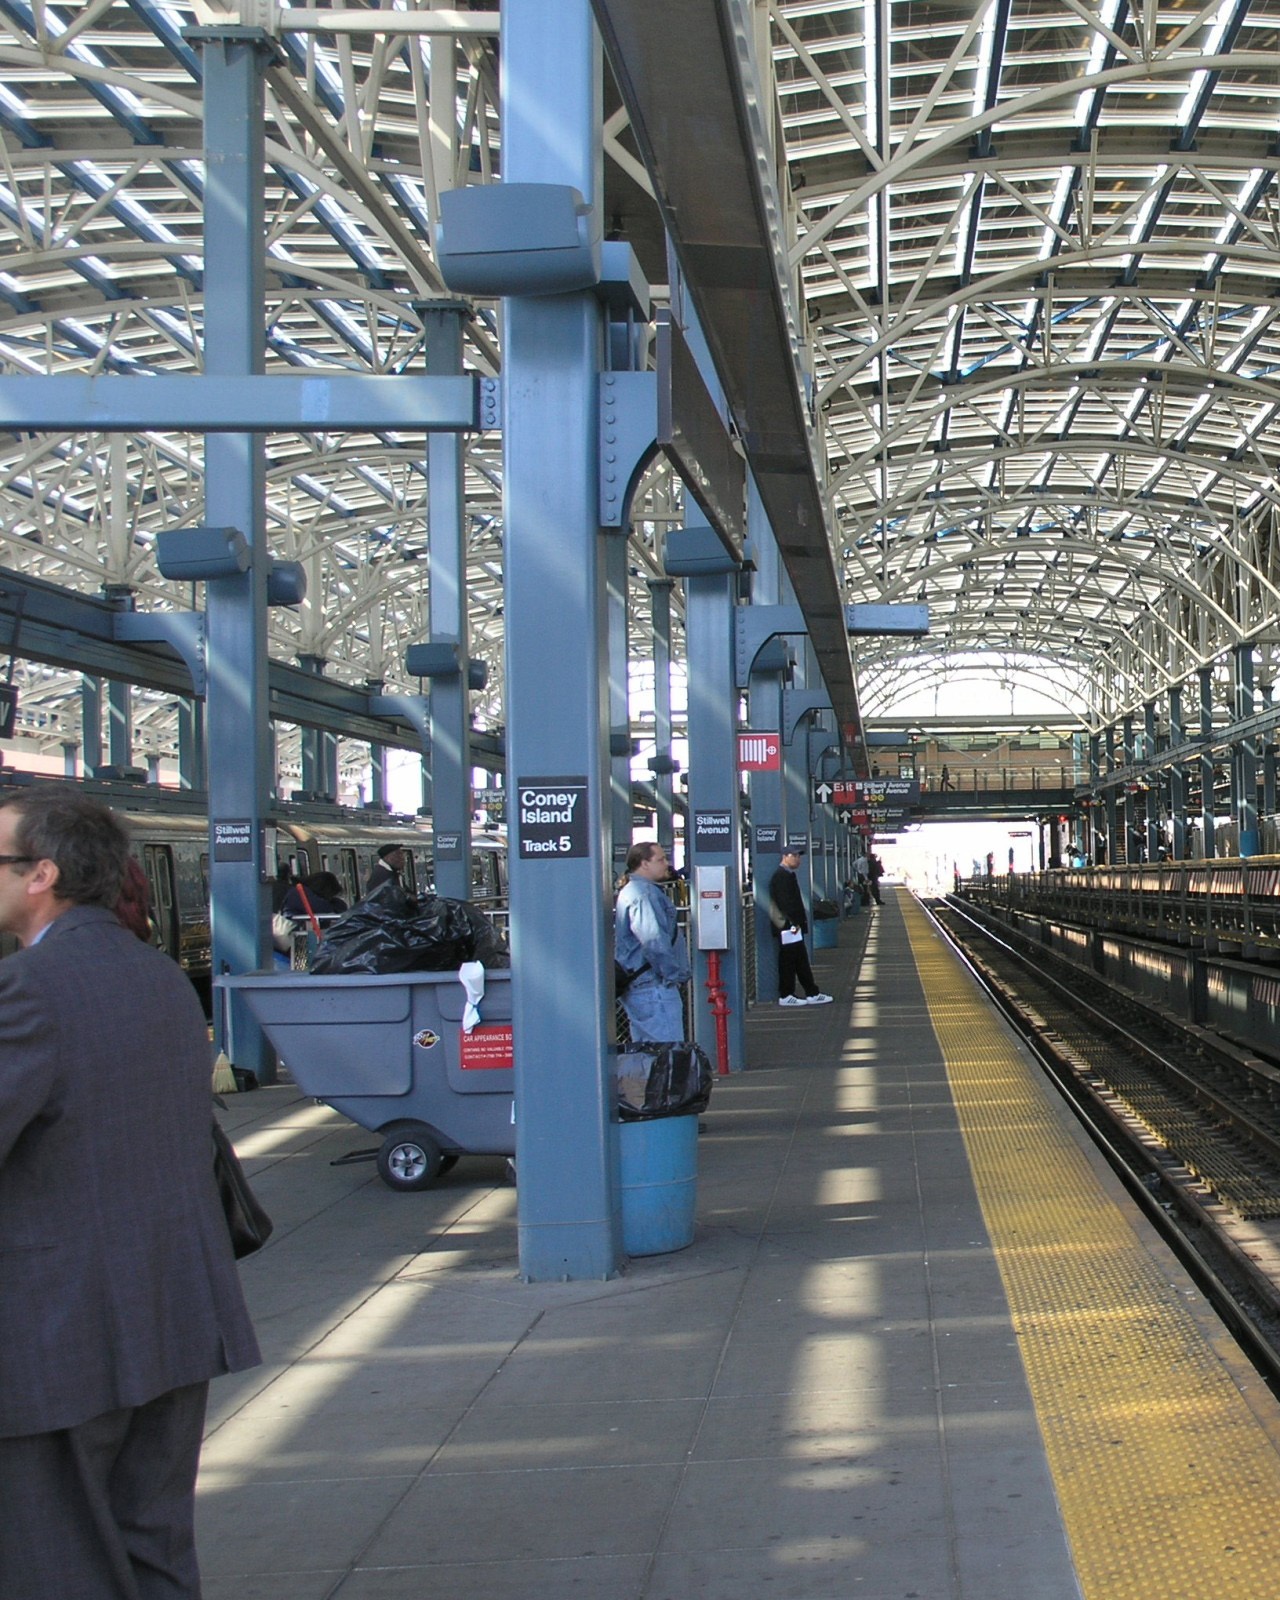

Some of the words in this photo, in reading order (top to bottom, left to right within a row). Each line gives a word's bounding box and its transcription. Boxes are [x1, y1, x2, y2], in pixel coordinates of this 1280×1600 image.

[522, 791, 577, 808] Coney
[522, 808, 572, 824] Island
[697, 816, 730, 826] Stillwell
[216, 826, 251, 835] Stillwell
[697, 826, 729, 834] Avenue
[757, 829, 777, 837] Coney
[216, 836, 250, 844] Avenue
[523, 840, 557, 852] Track
[559, 836, 572, 852] 5
